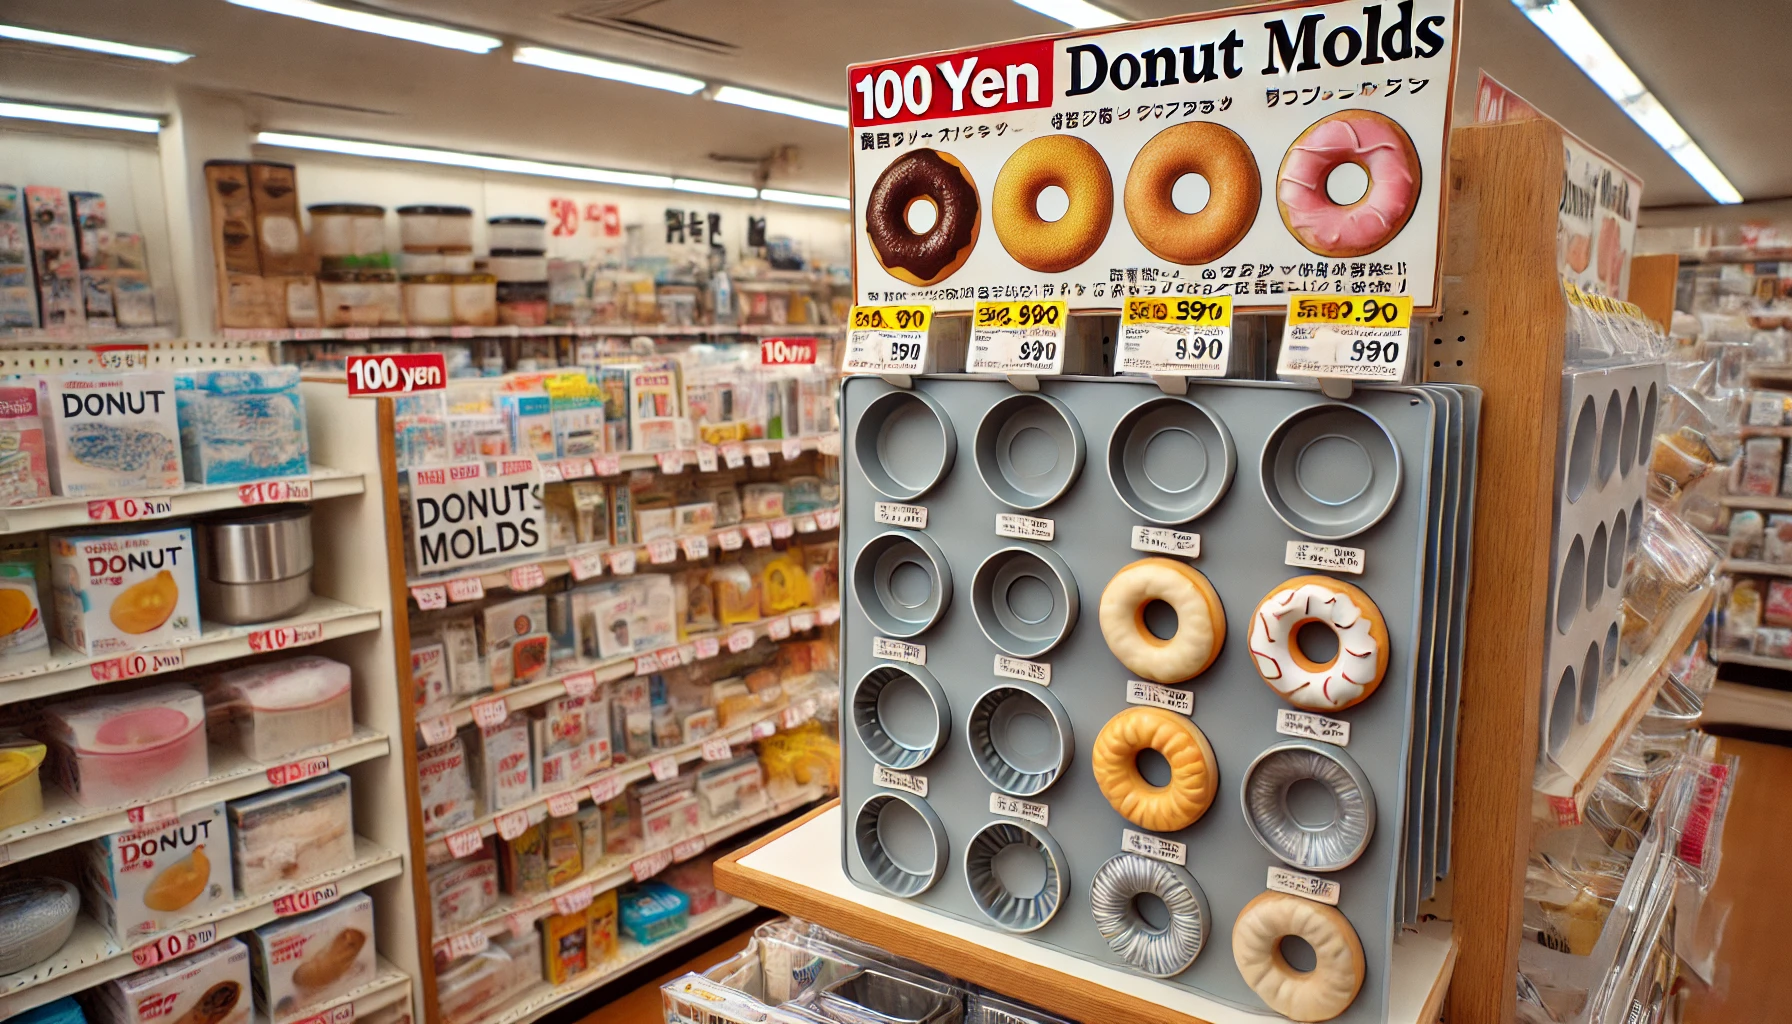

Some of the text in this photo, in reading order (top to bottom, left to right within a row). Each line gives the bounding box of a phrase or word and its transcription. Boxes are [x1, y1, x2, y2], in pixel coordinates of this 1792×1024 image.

[1065, 29, 1244, 97] Donut
[1261, 0, 1446, 75] Molds
[855, 57, 1040, 120] 100 Yen
[1350, 340, 1399, 362] 990
[349, 357, 441, 392] 100 yen
[62, 390, 165, 418] DONUT
[420, 517, 539, 566] MOLDS
[88, 546, 183, 577] DONUT
[118, 820, 212, 864] DONUT
